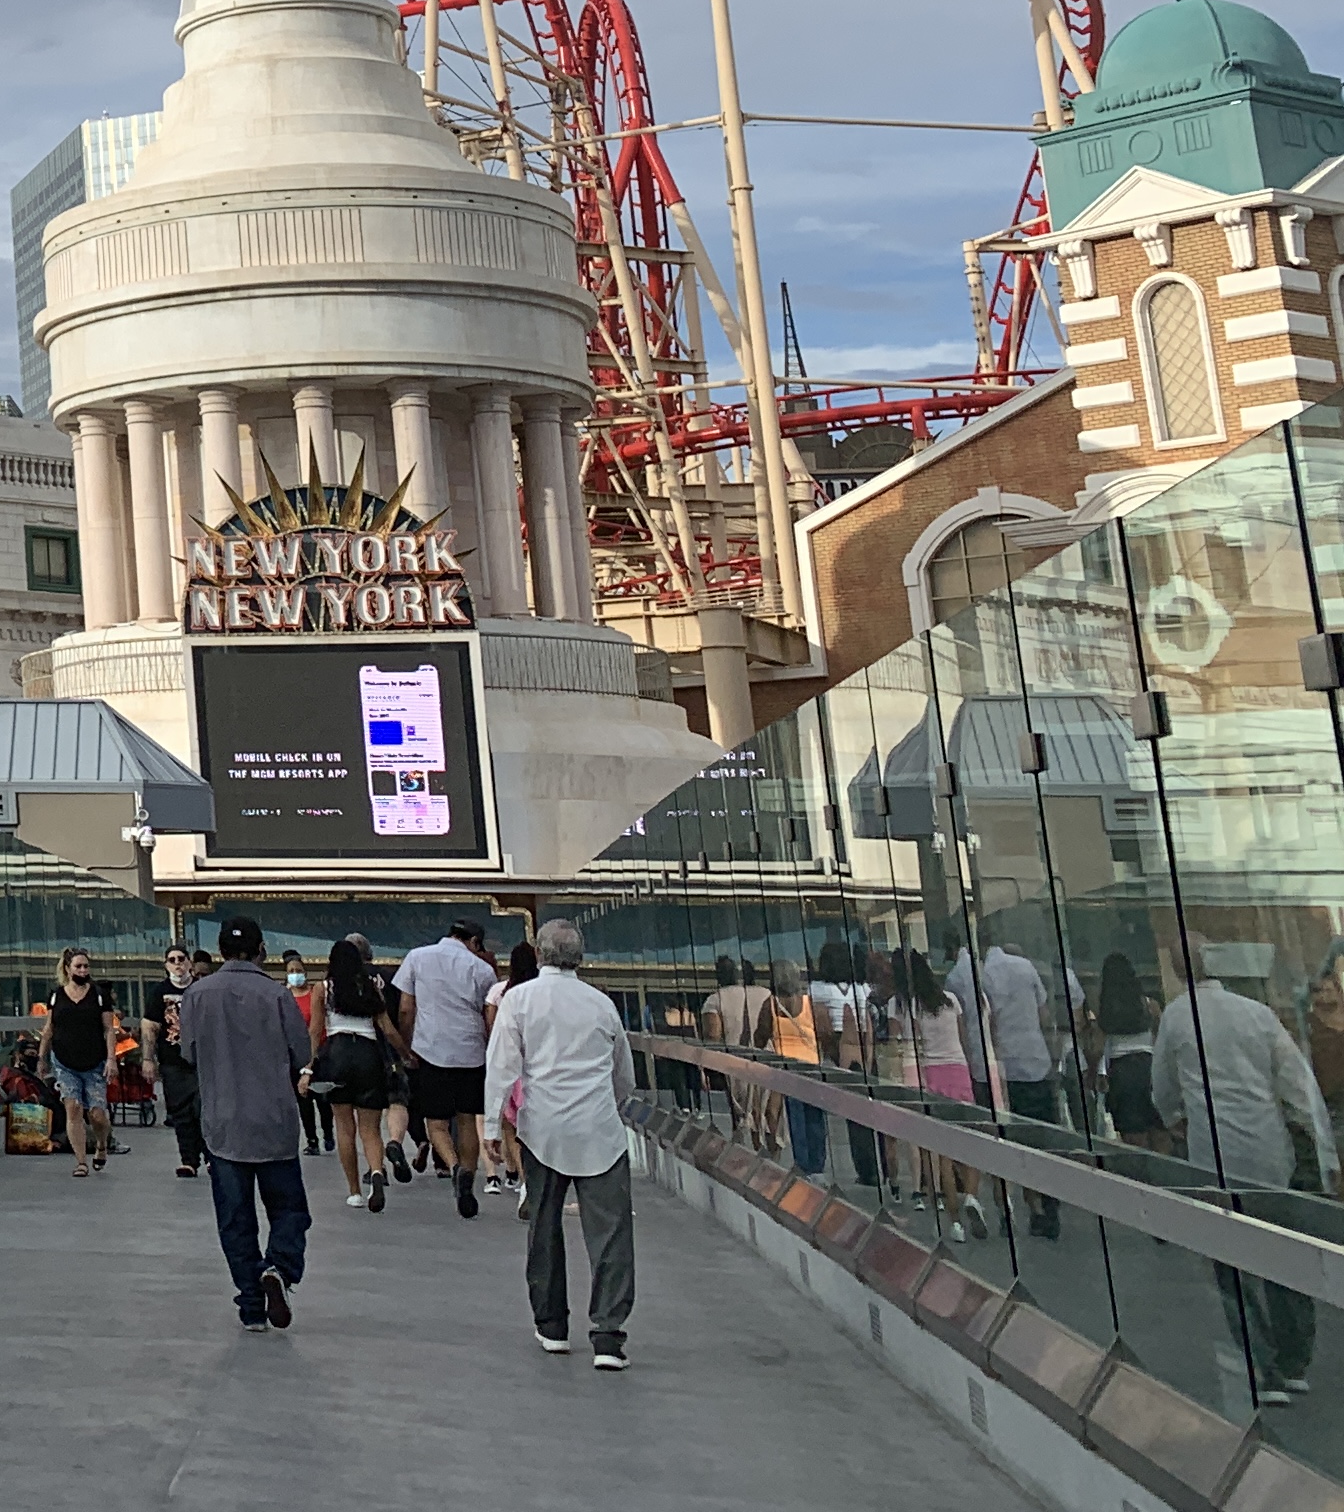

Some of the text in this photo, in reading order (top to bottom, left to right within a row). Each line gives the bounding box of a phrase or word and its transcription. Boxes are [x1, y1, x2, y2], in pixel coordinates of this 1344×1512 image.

[186, 529, 466, 578] NEW YORK
[189, 580, 470, 630] NEW YORK
[274, 752, 309, 763] CHECK
[278, 769, 325, 779] RESORTS
[327, 769, 348, 779] APP
